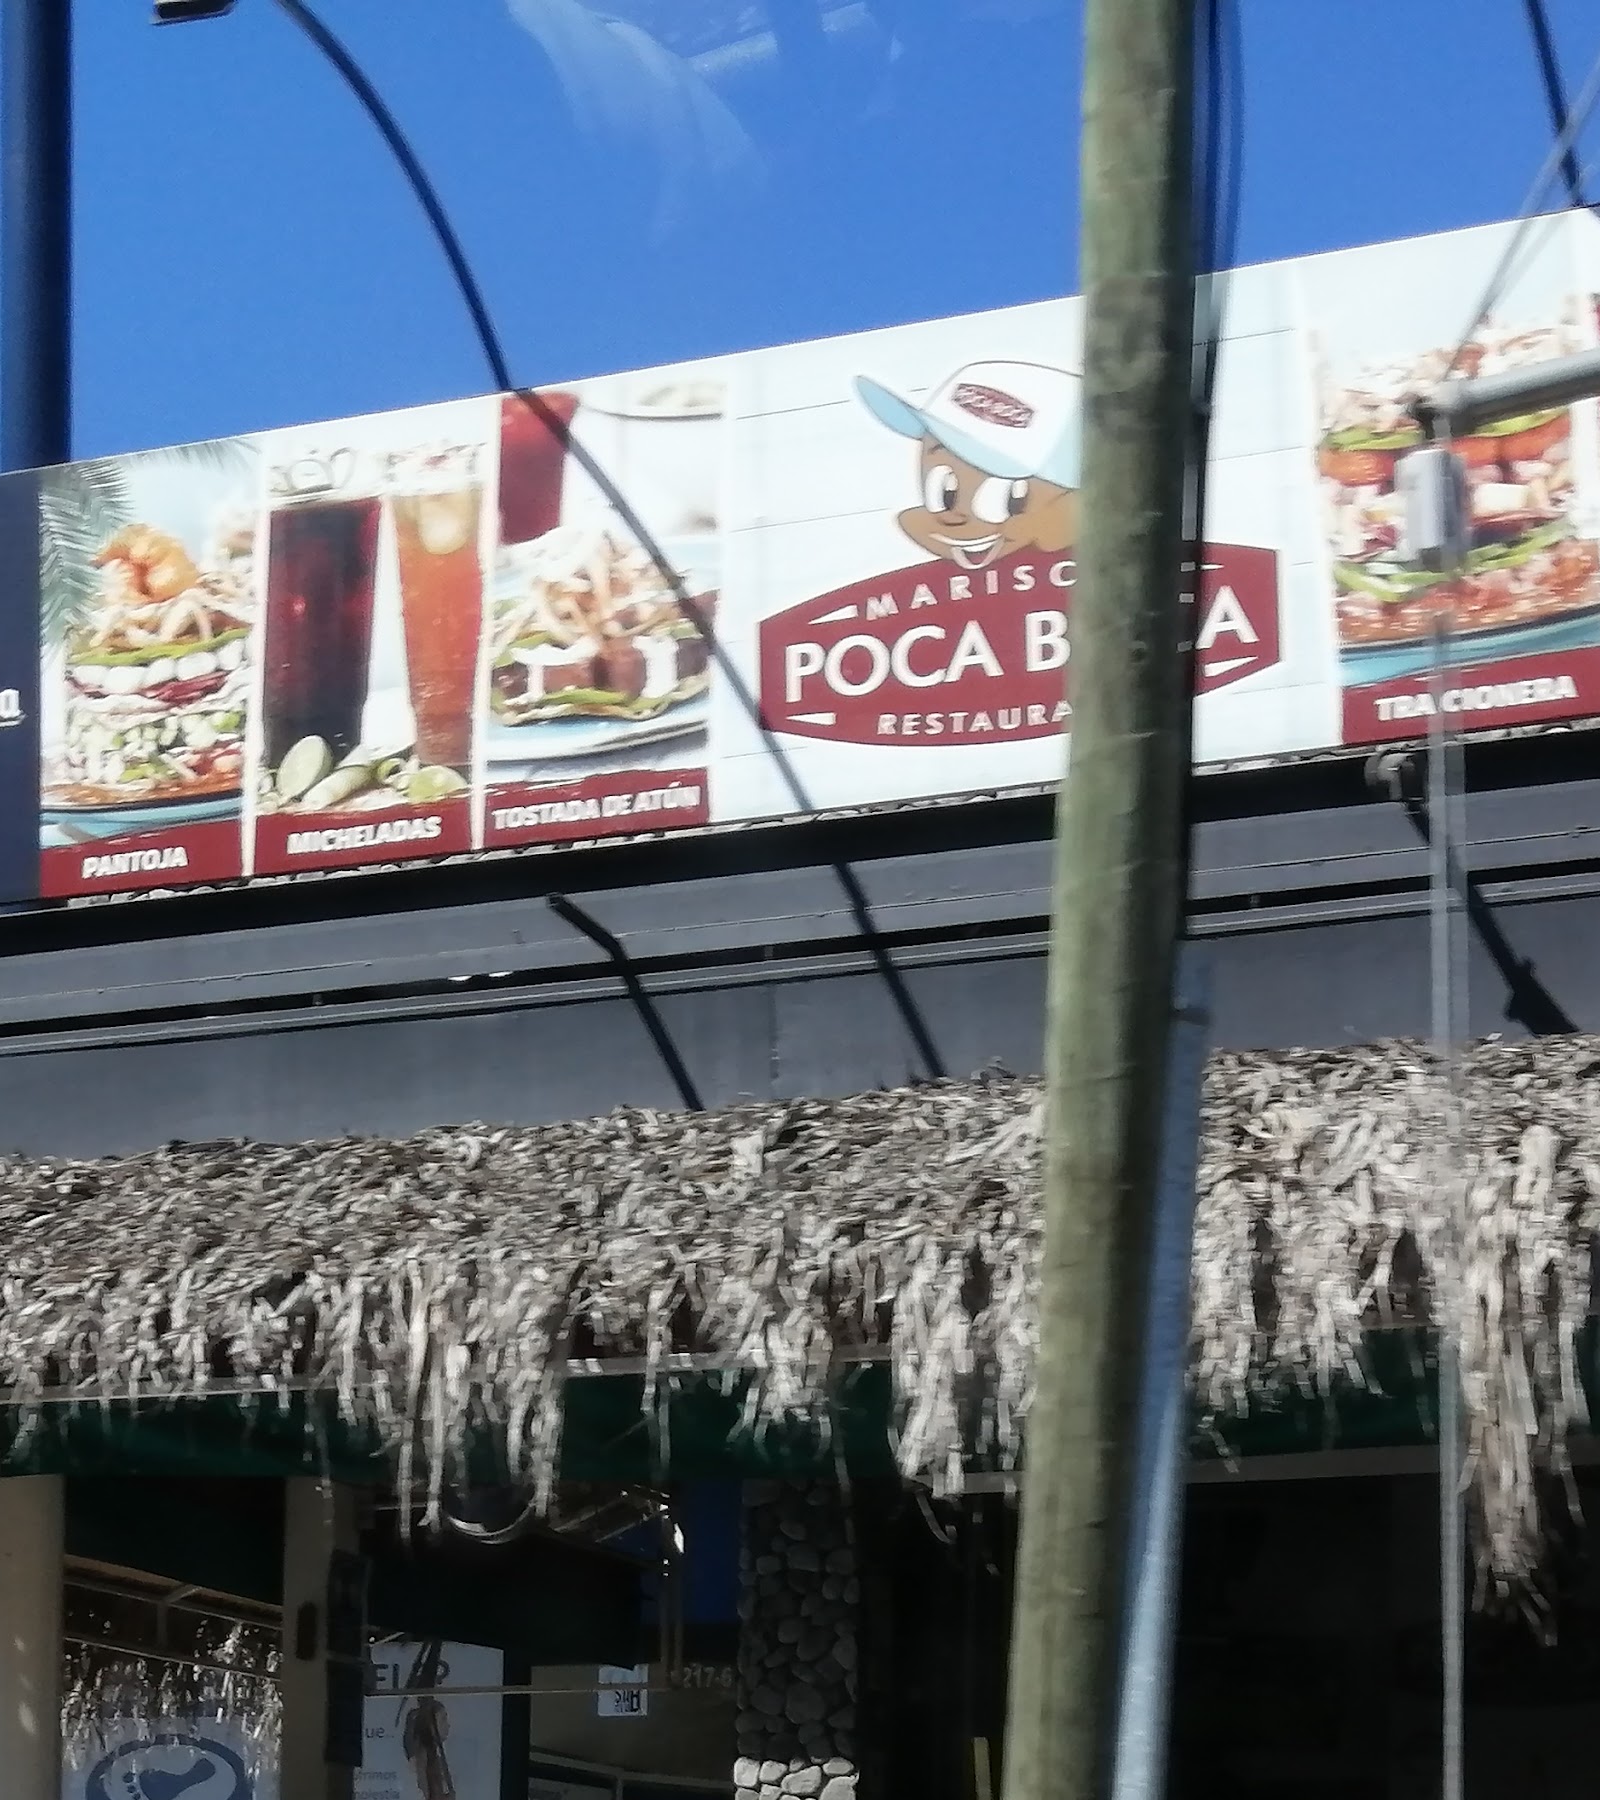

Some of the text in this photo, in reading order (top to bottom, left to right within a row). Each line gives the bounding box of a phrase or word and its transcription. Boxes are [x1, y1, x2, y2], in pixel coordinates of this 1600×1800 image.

[866, 560, 1079, 620] MARISC
[786, 584, 1260, 702] POCA BA
[878, 701, 1073, 736] RESTAURA
[1374, 675, 1580, 722] TRACIONERA
[492, 781, 701, 831] TOSTADA DE ATÚN
[286, 815, 443, 855] MICHELADAS
[81, 846, 188, 879] PANTOJA
